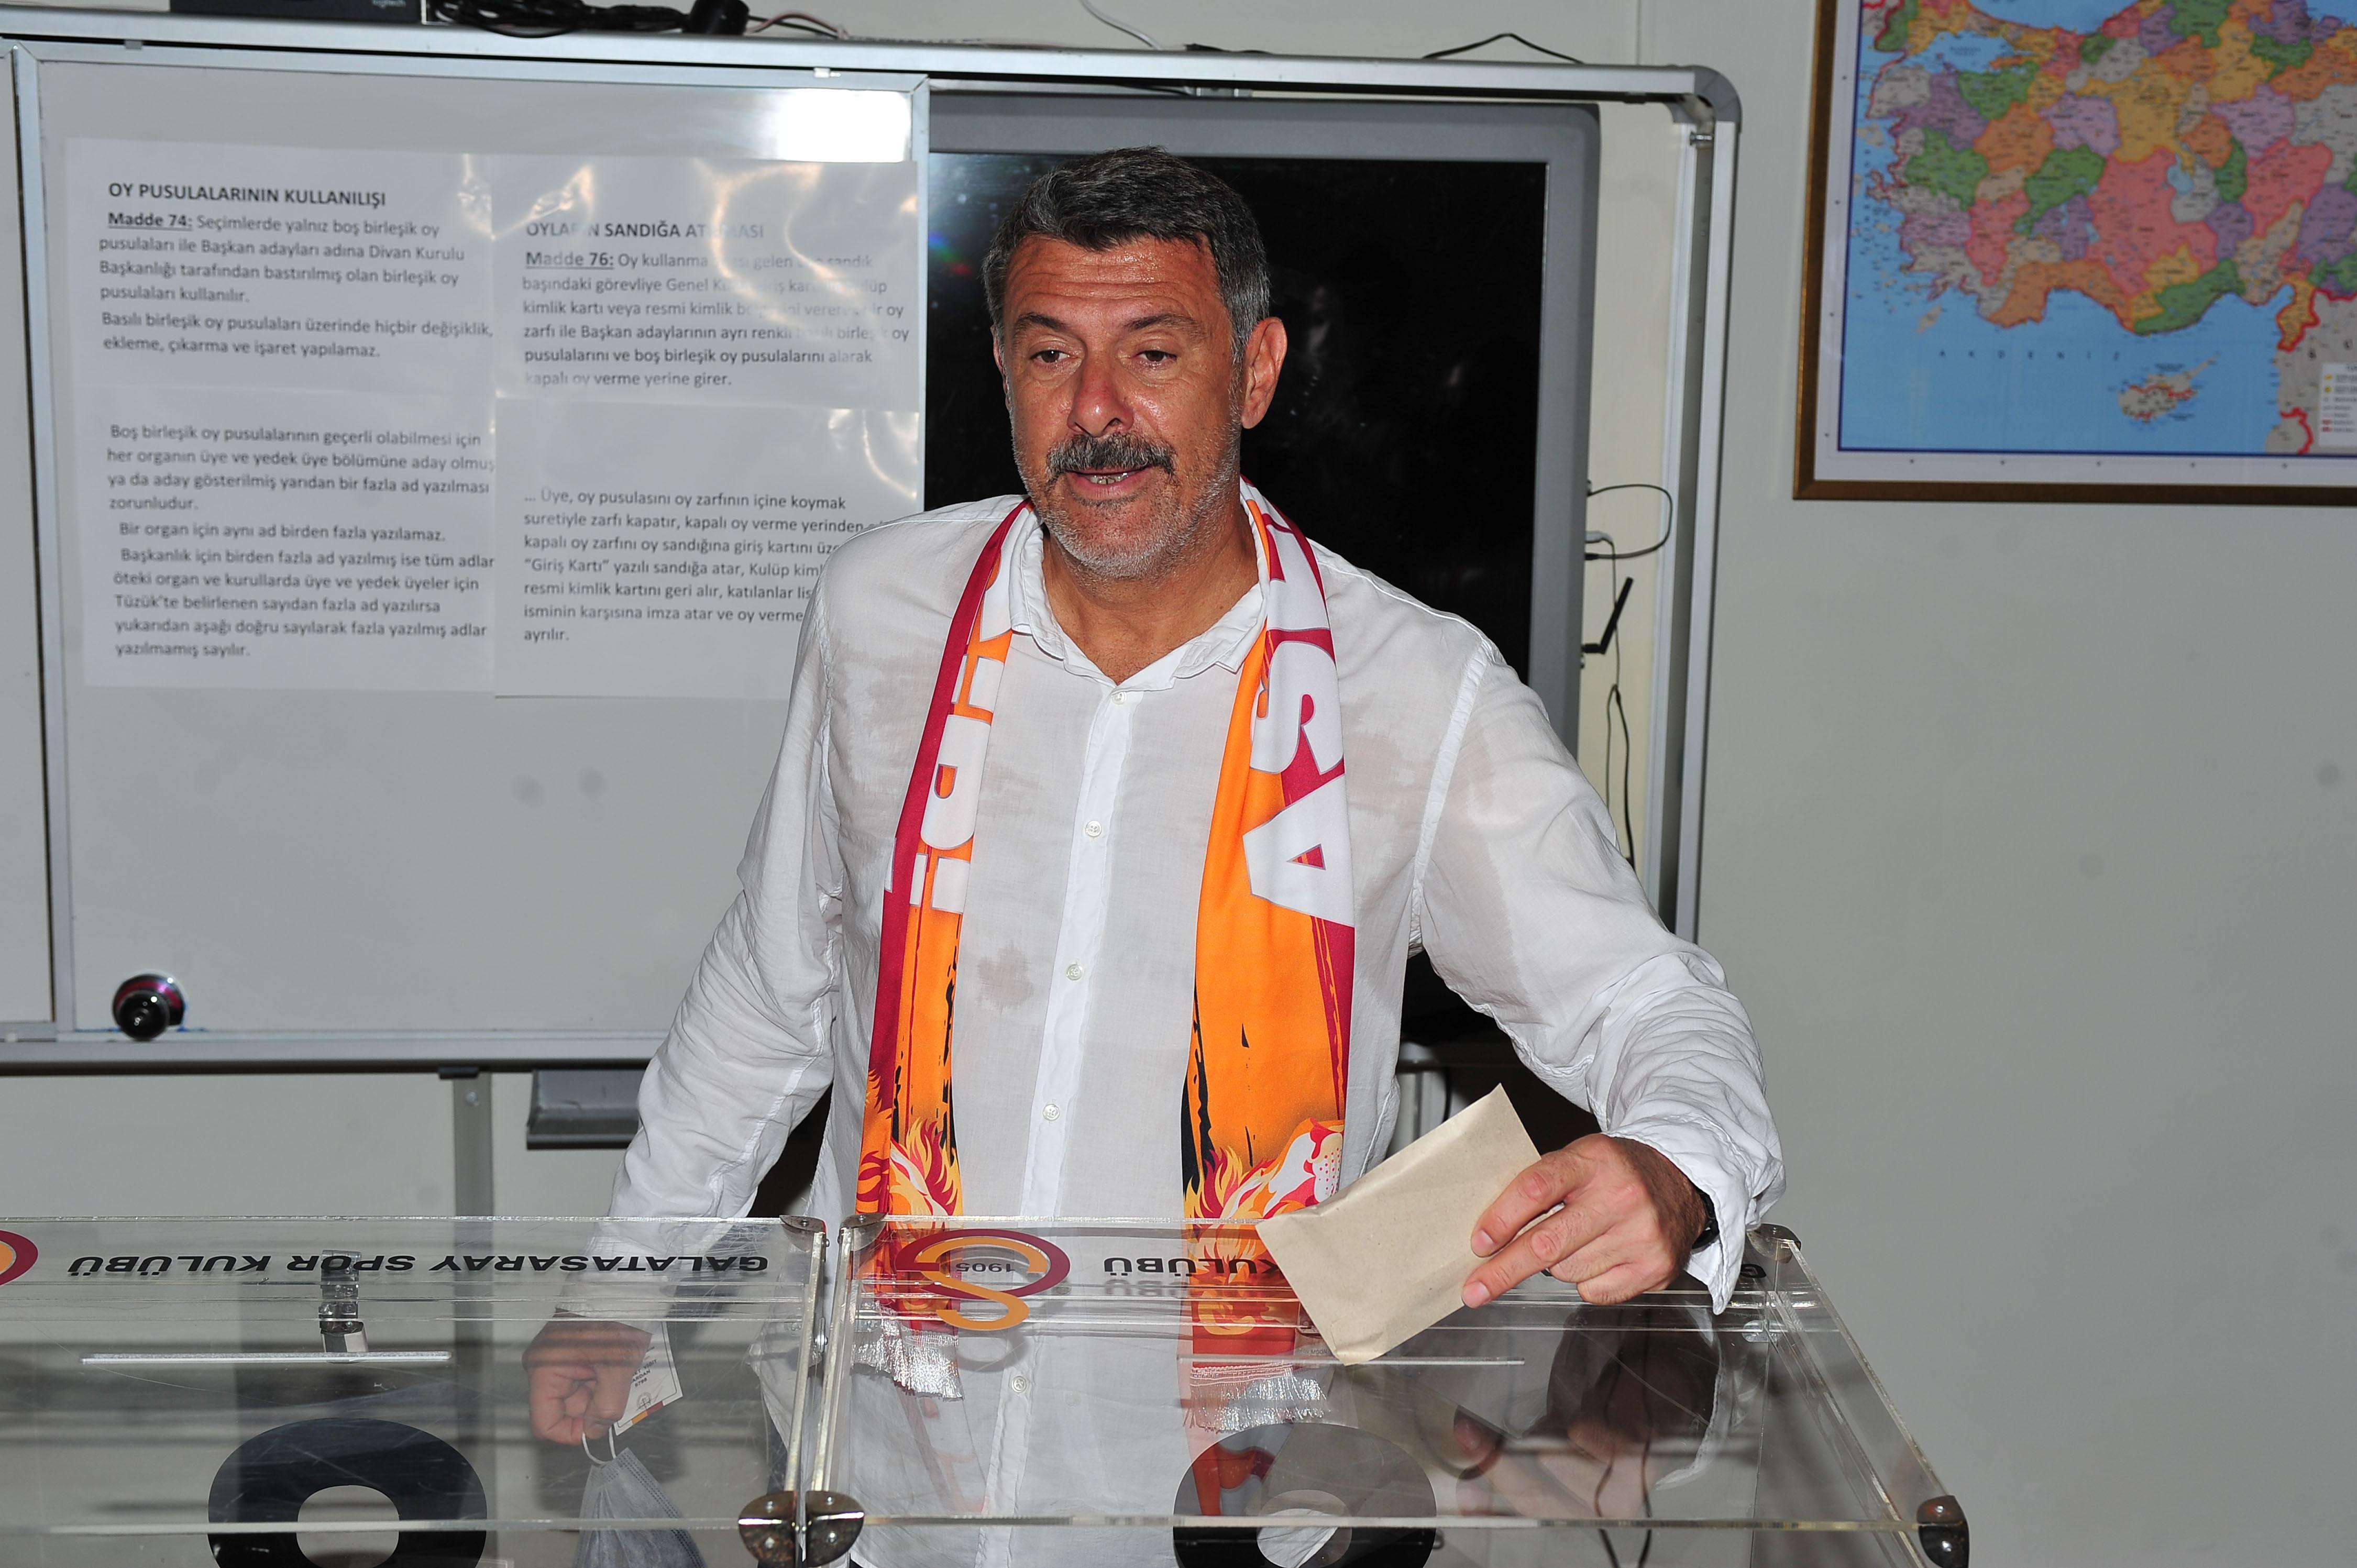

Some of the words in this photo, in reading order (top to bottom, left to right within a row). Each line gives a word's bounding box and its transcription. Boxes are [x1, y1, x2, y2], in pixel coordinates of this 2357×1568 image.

[108, 183, 133, 197] OY
[139, 184, 279, 202] PUSULALARININ
[284, 190, 386, 207] KULLANILIŞI
[108, 213, 167, 226] Madde
[166, 215, 192, 226] 74:
[196, 215, 282, 232] Seçimlerde
[284, 219, 329, 234] yalnız
[332, 220, 360, 236] boş
[363, 222, 417, 237] birleşik
[421, 226, 440, 238] oy
[605, 221, 681, 237] SANDIĞA
[98, 236, 174, 252] pusulaları
[178, 239, 197, 252] ile
[201, 240, 255, 256] Başkan
[259, 242, 320, 258] adayları
[323, 244, 365, 258] adına
[369, 245, 412, 259] Divan
[415, 247, 465, 260] Kurulu
[525, 252, 586, 269] Madde
[587, 252, 614, 270] 76:
[618, 253, 638, 269] Oy
[641, 253, 708, 267] kullanma
[753, 255, 793, 270] gelen
[100, 260, 177, 279] Başkanlığı
[180, 263, 260, 278] tarafından
[263, 266, 343, 282] bastırılmış
[345, 269, 379, 282] olan
[382, 270, 436, 285] birleşik
[439, 274, 459, 286] oy
[100, 285, 176, 300] pusulaları
[179, 288, 249, 302] kullanılır.
[595, 278, 662, 293] görevliye
[666, 278, 708, 291] Genel
[523, 301, 567, 313] kimlik
[569, 302, 603, 314] kartı
[607, 304, 641, 317] veya
[645, 305, 686, 315] resmi
[689, 302, 733, 314] kimlik
[886, 306, 904, 318] oy
[102, 312, 142, 326] Basılı
[145, 314, 201, 329] birleşik
[204, 318, 224, 330] oy
[227, 316, 301, 332] pusulaları
[305, 319, 371, 333] üzerinde
[375, 321, 417, 336] hiçbir
[421, 322, 493, 338] değişiklik,
[523, 324, 555, 337] zarfı
[559, 325, 577, 338] ile
[581, 326, 632, 340] Başkan
[635, 326, 717, 340] adaylarının
[720, 329, 747, 341] ayrı
[751, 329, 792, 339] renkli
[891, 330, 910, 341] oy
[103, 337, 164, 350] ekleme,
[168, 339, 229, 354] çıkarma
[232, 344, 251, 353] ve
[254, 343, 296, 356] işaret
[300, 344, 380, 358] yapılamaz.
[524, 349, 609, 361] pusulalarını
[612, 352, 631, 361] ve
[634, 349, 660, 365] boş
[664, 349, 716, 363] birleşik
[719, 352, 738, 364] oy
[741, 350, 824, 363] pusulalarını
[828, 349, 873, 363] alarak
[593, 375, 641, 385] verme
[644, 372, 690, 387] yerine
[693, 373, 732, 388] girer.
[541, 490, 574, 504] Üye,
[577, 493, 596, 505] oy
[599, 492, 671, 505] pusulasını
[674, 496, 692, 507] oy
[696, 493, 750, 506] zarfının
[754, 497, 787, 510] içine
[791, 496, 846, 511] koymak
[524, 512, 587, 527] suretiyle
[590, 513, 622, 526] zarfı
[626, 515, 680, 529] kapatır,
[685, 516, 727, 531] kapalı
[731, 520, 749, 532] oy
[752, 520, 798, 530] verme
[801, 518, 864, 533] yerinden
[524, 535, 567, 550] kapalı
[570, 539, 589, 551] oy
[592, 536, 637, 549] zarfını
[640, 540, 659, 553] oy
[663, 538, 730, 554] sandığına
[734, 540, 764, 555] giriş
[767, 539, 813, 554] kartını
[613, 560, 649, 575] yazılı
[653, 561, 708, 577] sandığa
[711, 564, 745, 576] atar,
[749, 563, 790, 578] Kulüp
[524, 585, 565, 594] resmi
[568, 582, 611, 594] kimlik
[615, 583, 661, 595] kartını
[664, 587, 692, 599] geri
[696, 584, 723, 599] alır,
[727, 586, 794, 599] katılanlar
[524, 605, 576, 617] isminin
[580, 606, 643, 620] karşısına
[646, 607, 680, 619] imza
[684, 610, 713, 620] atar
[717, 611, 734, 620] ve
[737, 611, 755, 623] oy
[758, 609, 804, 621] verme
[524, 628, 569, 643] ayrılır.
[68, 1255, 271, 1277] KULÜBÜ
[287, 1255, 417, 1272] SPOR
[429, 1255, 768, 1272] GALATASARAY
[956, 1263, 1015, 1272] 1905
